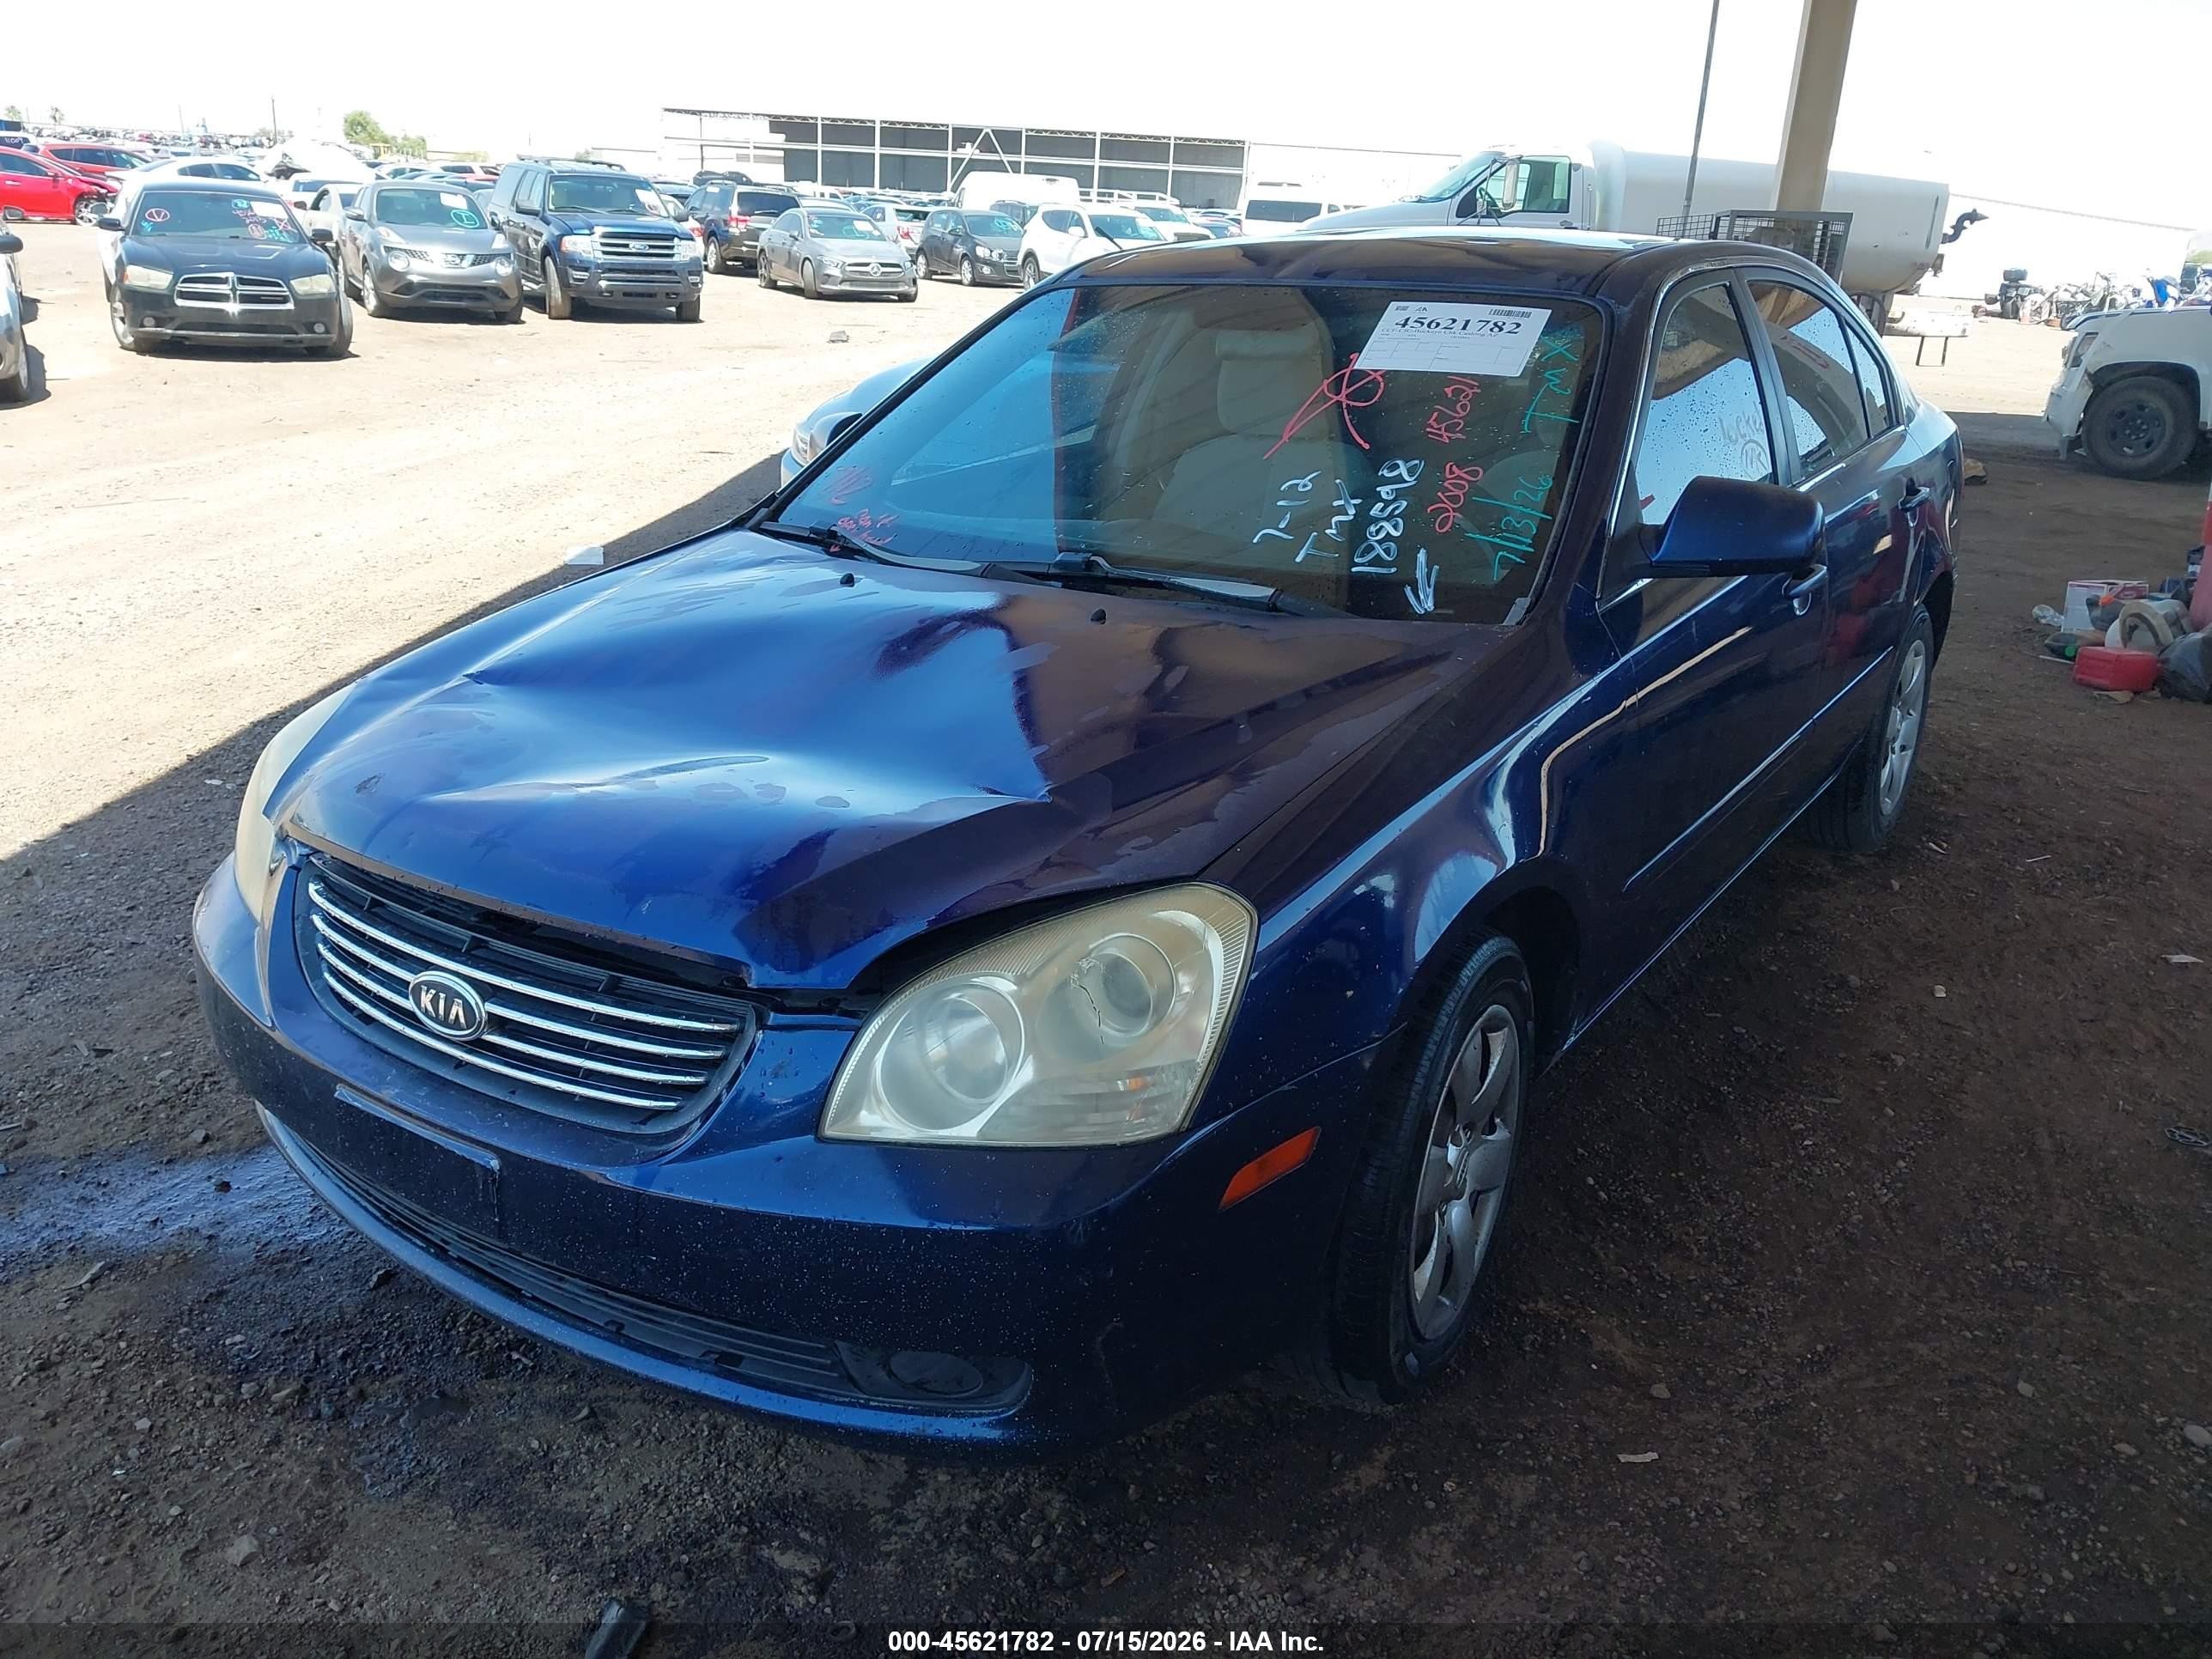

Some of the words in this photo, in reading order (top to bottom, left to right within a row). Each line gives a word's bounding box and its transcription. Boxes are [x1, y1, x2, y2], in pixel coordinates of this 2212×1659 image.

[1395, 315, 1522, 335] 45621782
[1425, 376, 1479, 445] 45621
[1253, 470, 1322, 544] 7-12
[1351, 459, 1425, 574] 188598
[1426, 462, 1485, 534] 2008
[419, 985, 468, 1030] KIA
